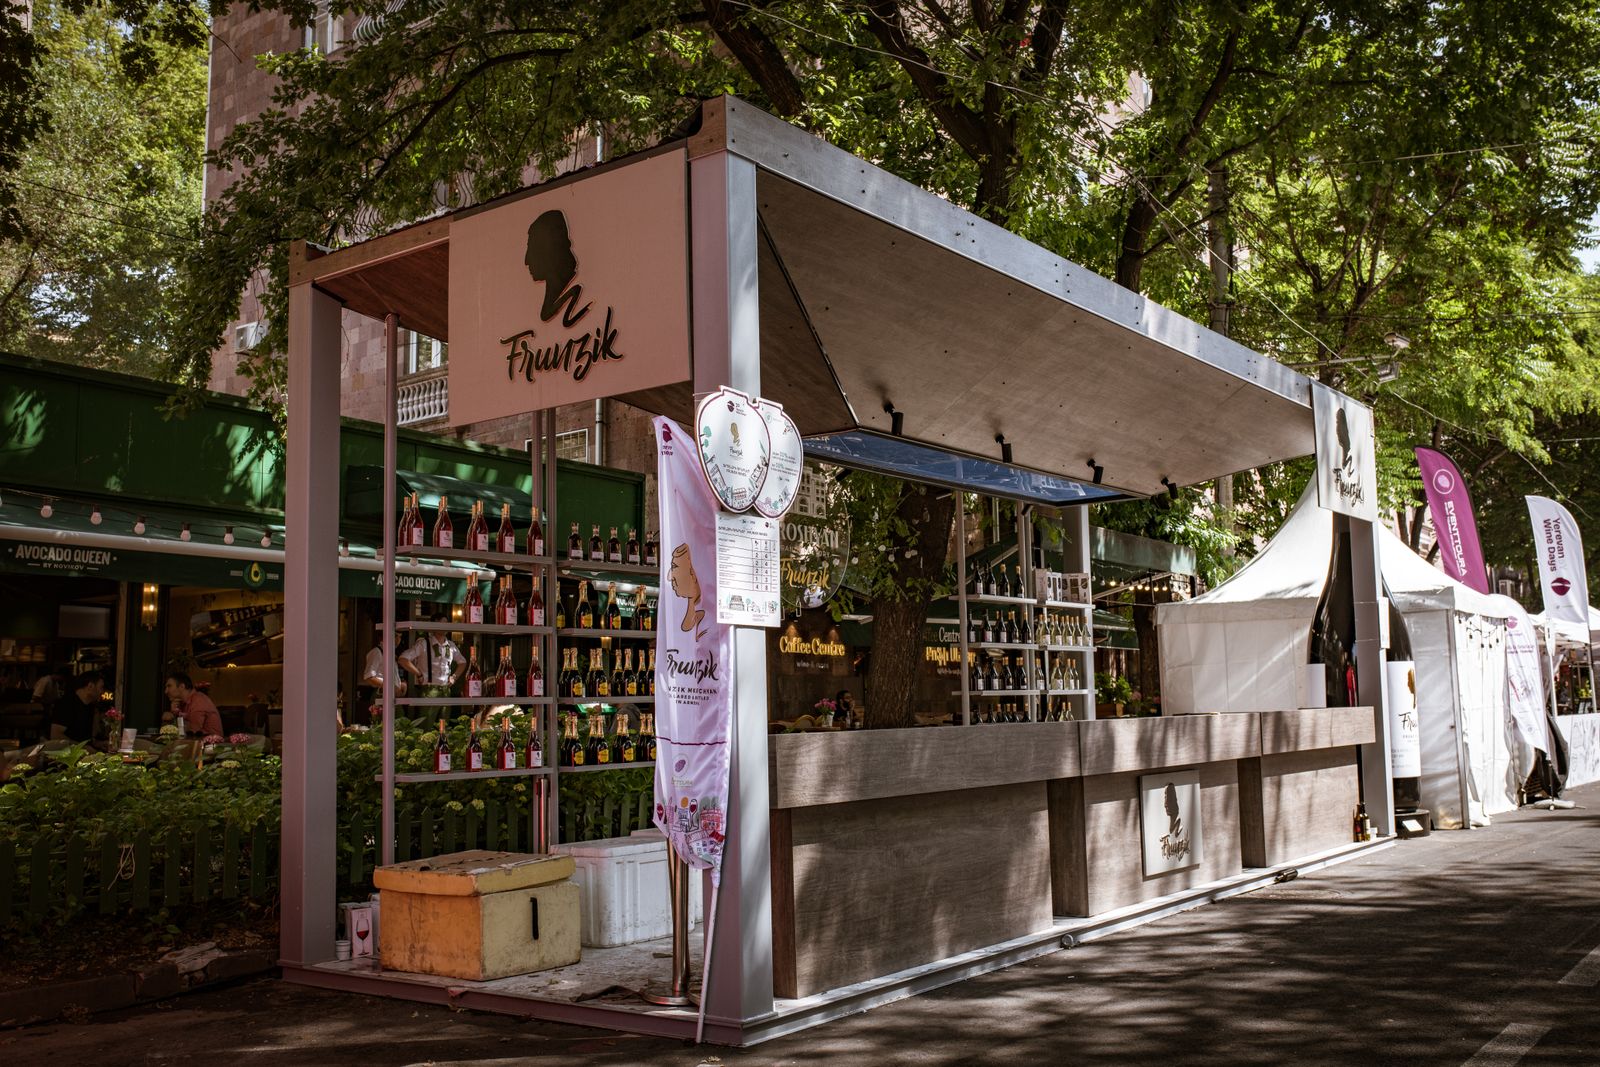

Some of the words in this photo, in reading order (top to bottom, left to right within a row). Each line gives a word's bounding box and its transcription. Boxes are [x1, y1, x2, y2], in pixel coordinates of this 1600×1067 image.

[500, 306, 623, 382] Frunzik
[1333, 468, 1365, 508] Frunzik
[1543, 519, 1554, 545] Wine
[1553, 518, 1566, 559] Yerevan
[15, 544, 72, 562] AVOCADO
[73, 548, 111, 566] QUEEN
[53, 563, 85, 571] NOVIKOV
[1547, 546, 1558, 572] Days
[377, 573, 414, 588] ACADO
[415, 577, 441, 591] QUEEN
[780, 557, 832, 594] Frunzik
[779, 635, 811, 654] Coffee
[811, 637, 846, 656] Centre
[1160, 829, 1191, 862] Frunzik
